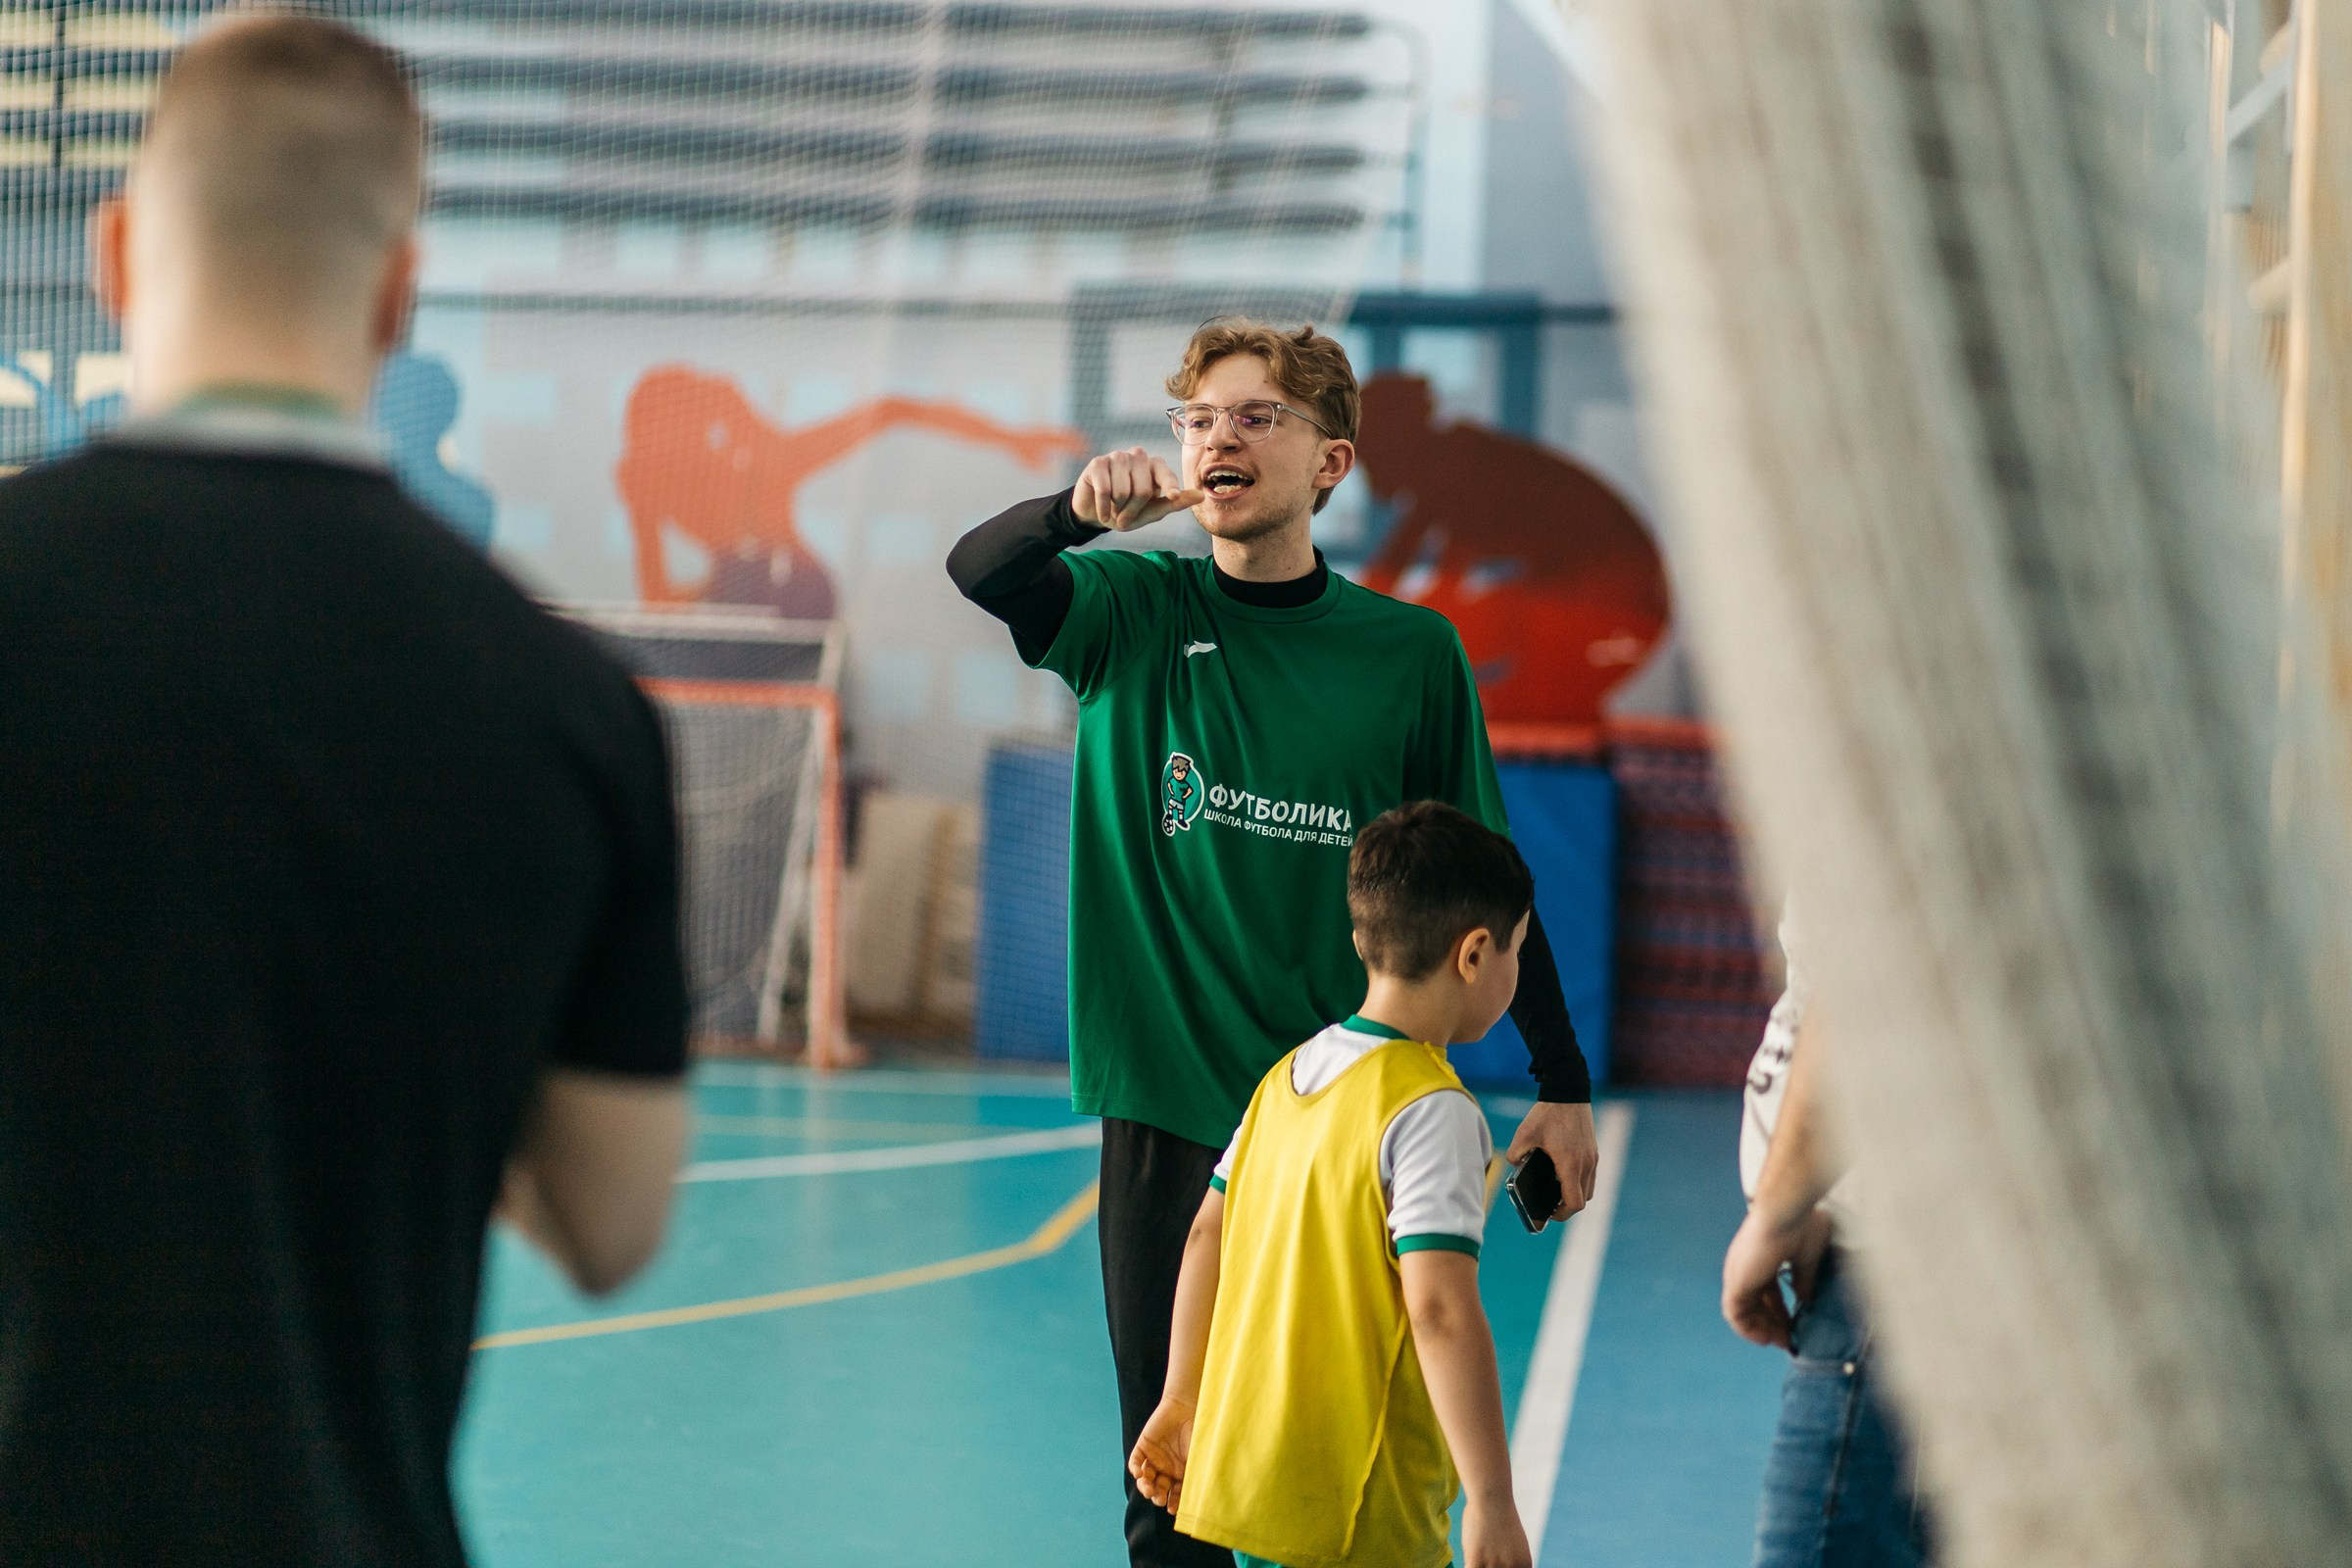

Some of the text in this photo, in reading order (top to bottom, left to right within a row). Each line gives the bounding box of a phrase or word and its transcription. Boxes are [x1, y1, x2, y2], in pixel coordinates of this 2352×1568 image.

[1203, 808, 1353, 847] ШКОЛА ФУТБОЛА ДЛЯ ДЕТЕЙ
